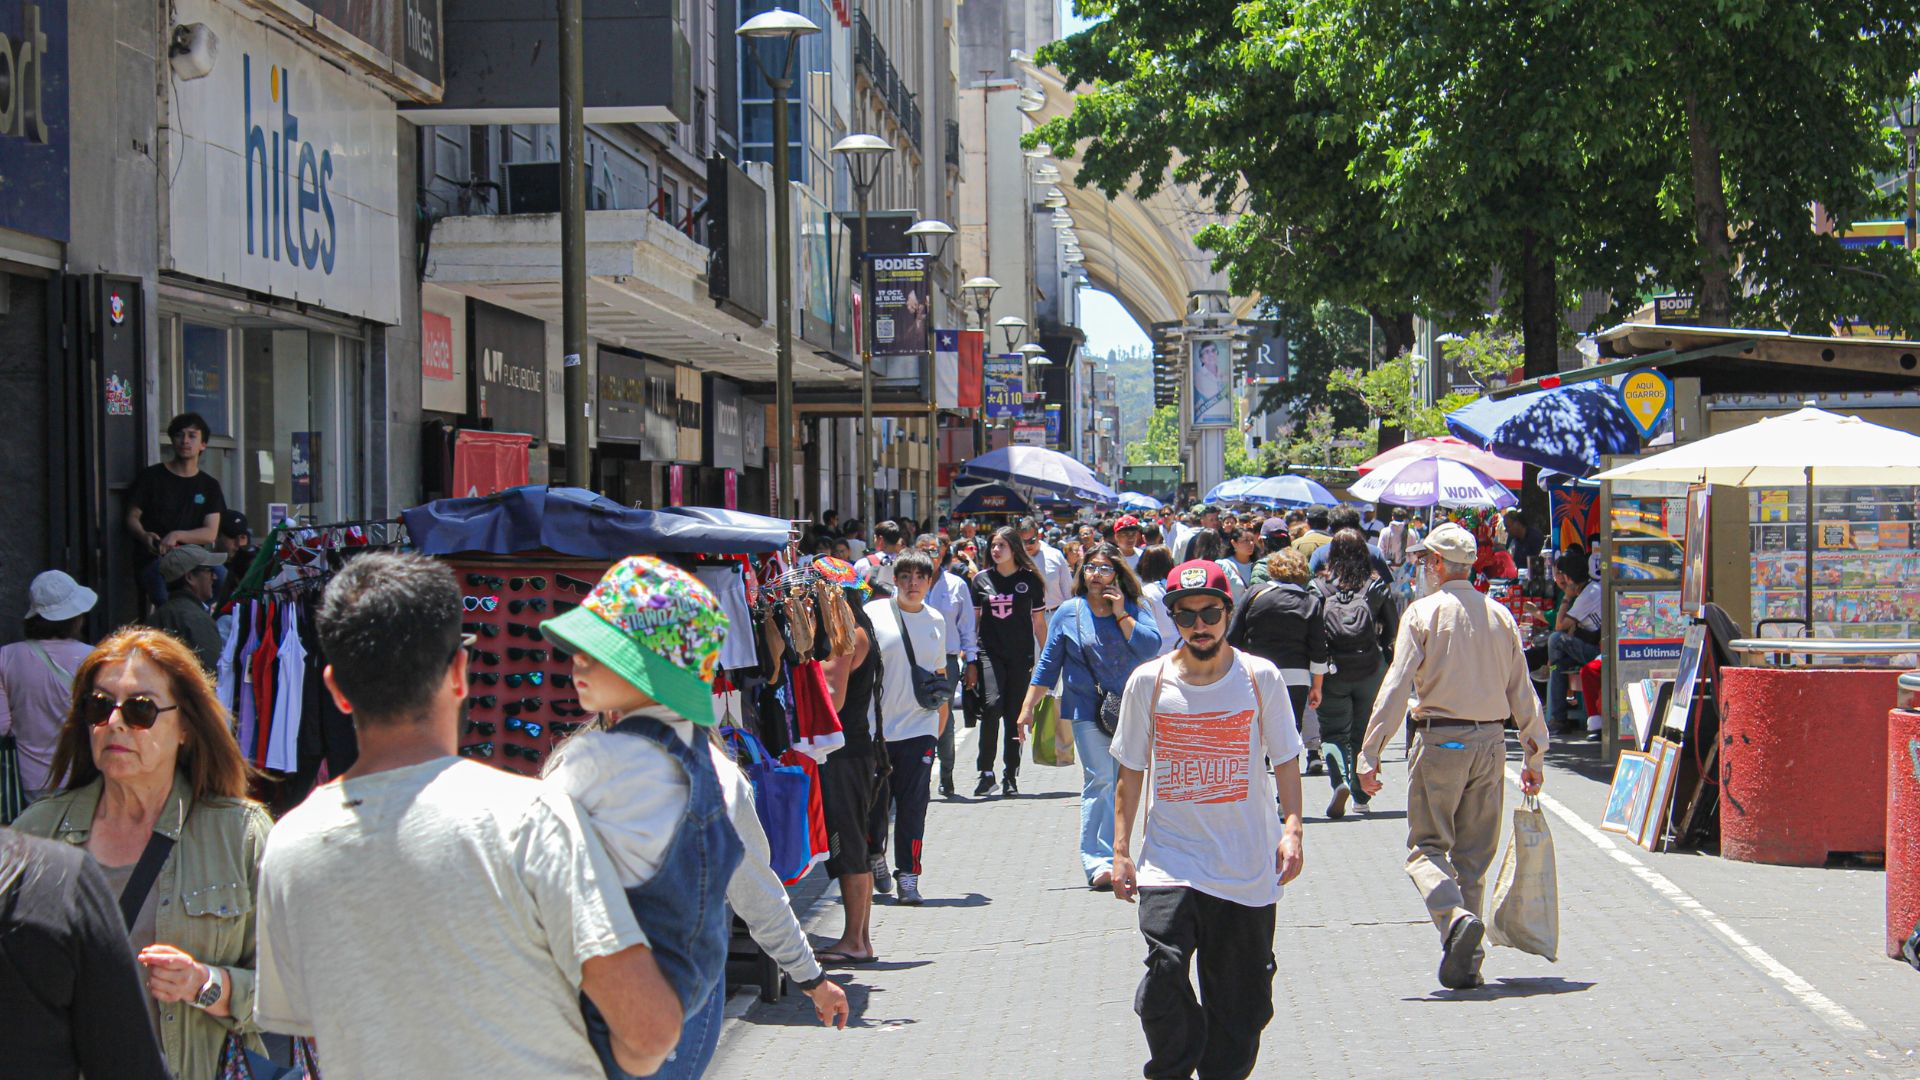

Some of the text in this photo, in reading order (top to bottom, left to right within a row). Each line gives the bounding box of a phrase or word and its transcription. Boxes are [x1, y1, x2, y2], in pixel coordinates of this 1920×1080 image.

[243, 53, 335, 275] hites
[875, 258, 924, 270] BODIES
[1257, 343, 1276, 365] R
[1626, 391, 1664, 399] CIGARROS
[1394, 481, 1434, 496] WOM
[1443, 486, 1483, 499] WOM
[1625, 646, 1681, 658] Las Últimas
[1170, 759, 1239, 785] REVUP
